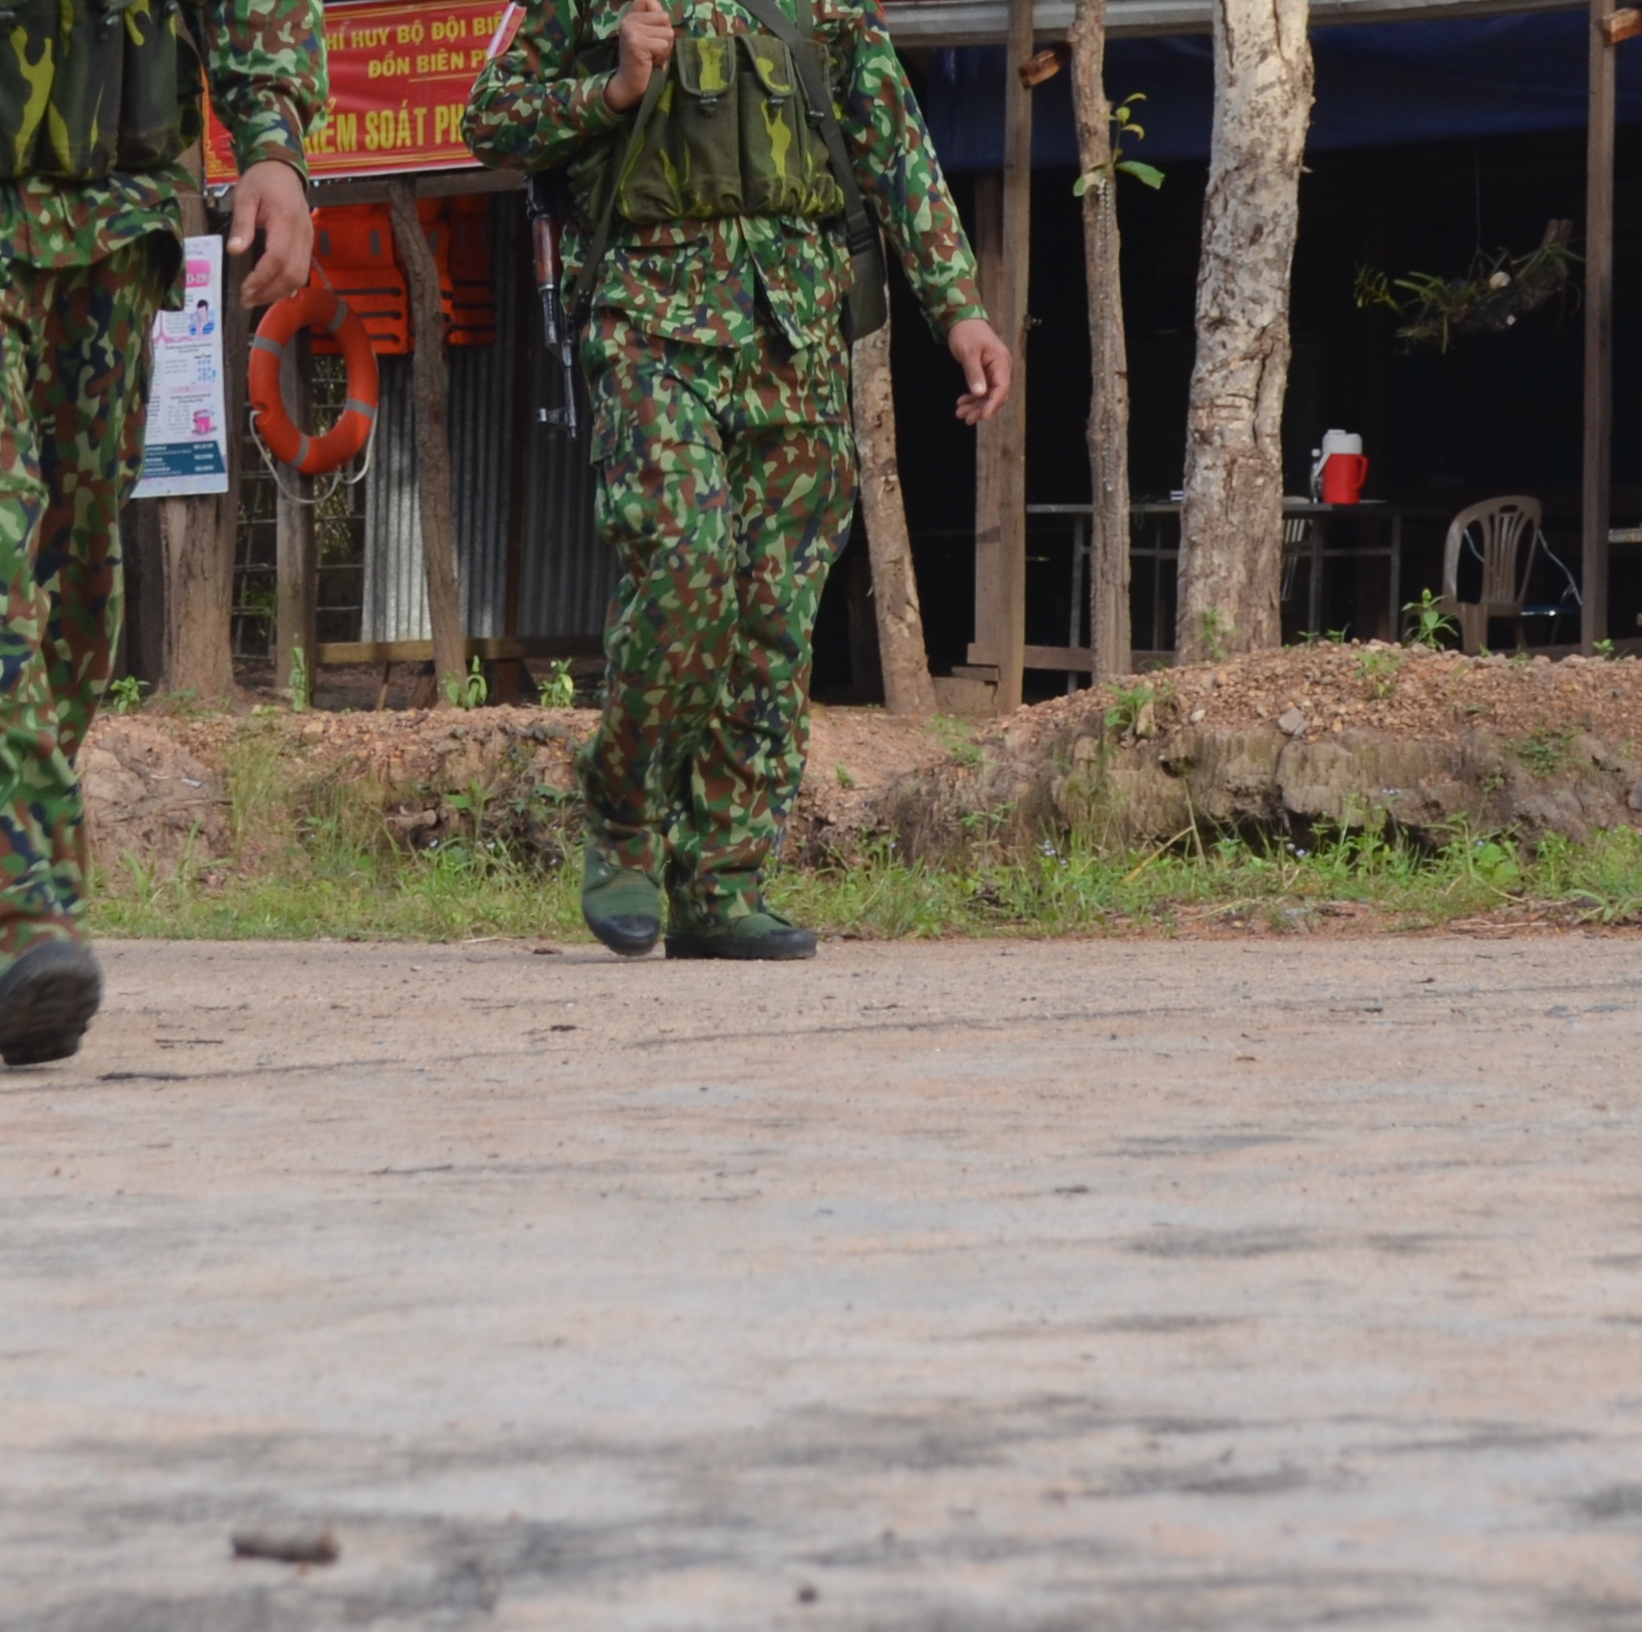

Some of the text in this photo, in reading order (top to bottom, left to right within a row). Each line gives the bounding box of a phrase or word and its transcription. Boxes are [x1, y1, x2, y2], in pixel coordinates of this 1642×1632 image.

[326, 10, 502, 50] HỈ HUY BỘ ĐỘI BIÊ
[368, 48, 487, 79] ĐỒN BIÊN P
[365, 99, 427, 151] SOÁT
[435, 103, 464, 145] PH
